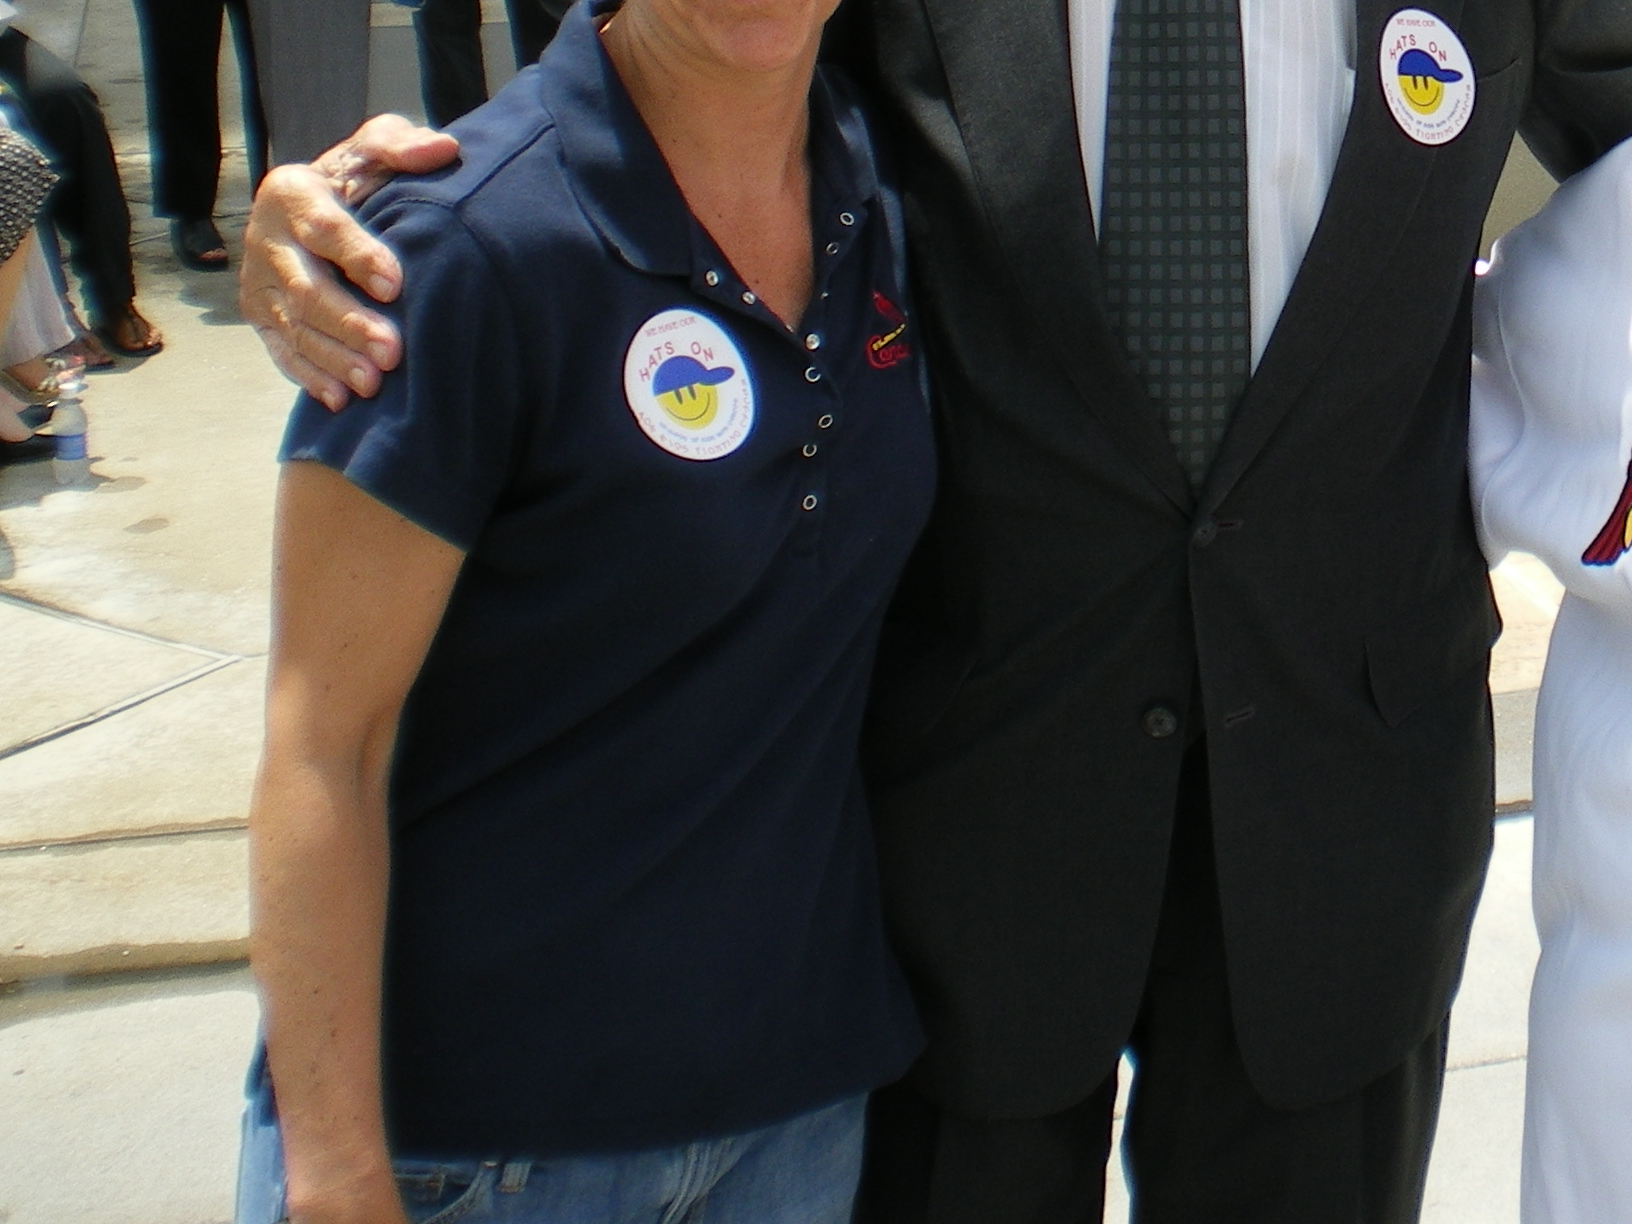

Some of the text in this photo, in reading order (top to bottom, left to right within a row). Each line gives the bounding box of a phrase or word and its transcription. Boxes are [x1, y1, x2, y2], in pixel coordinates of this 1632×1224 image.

[1389, 33, 1447, 62] HATS ON
[639, 341, 714, 382] HATS ON
